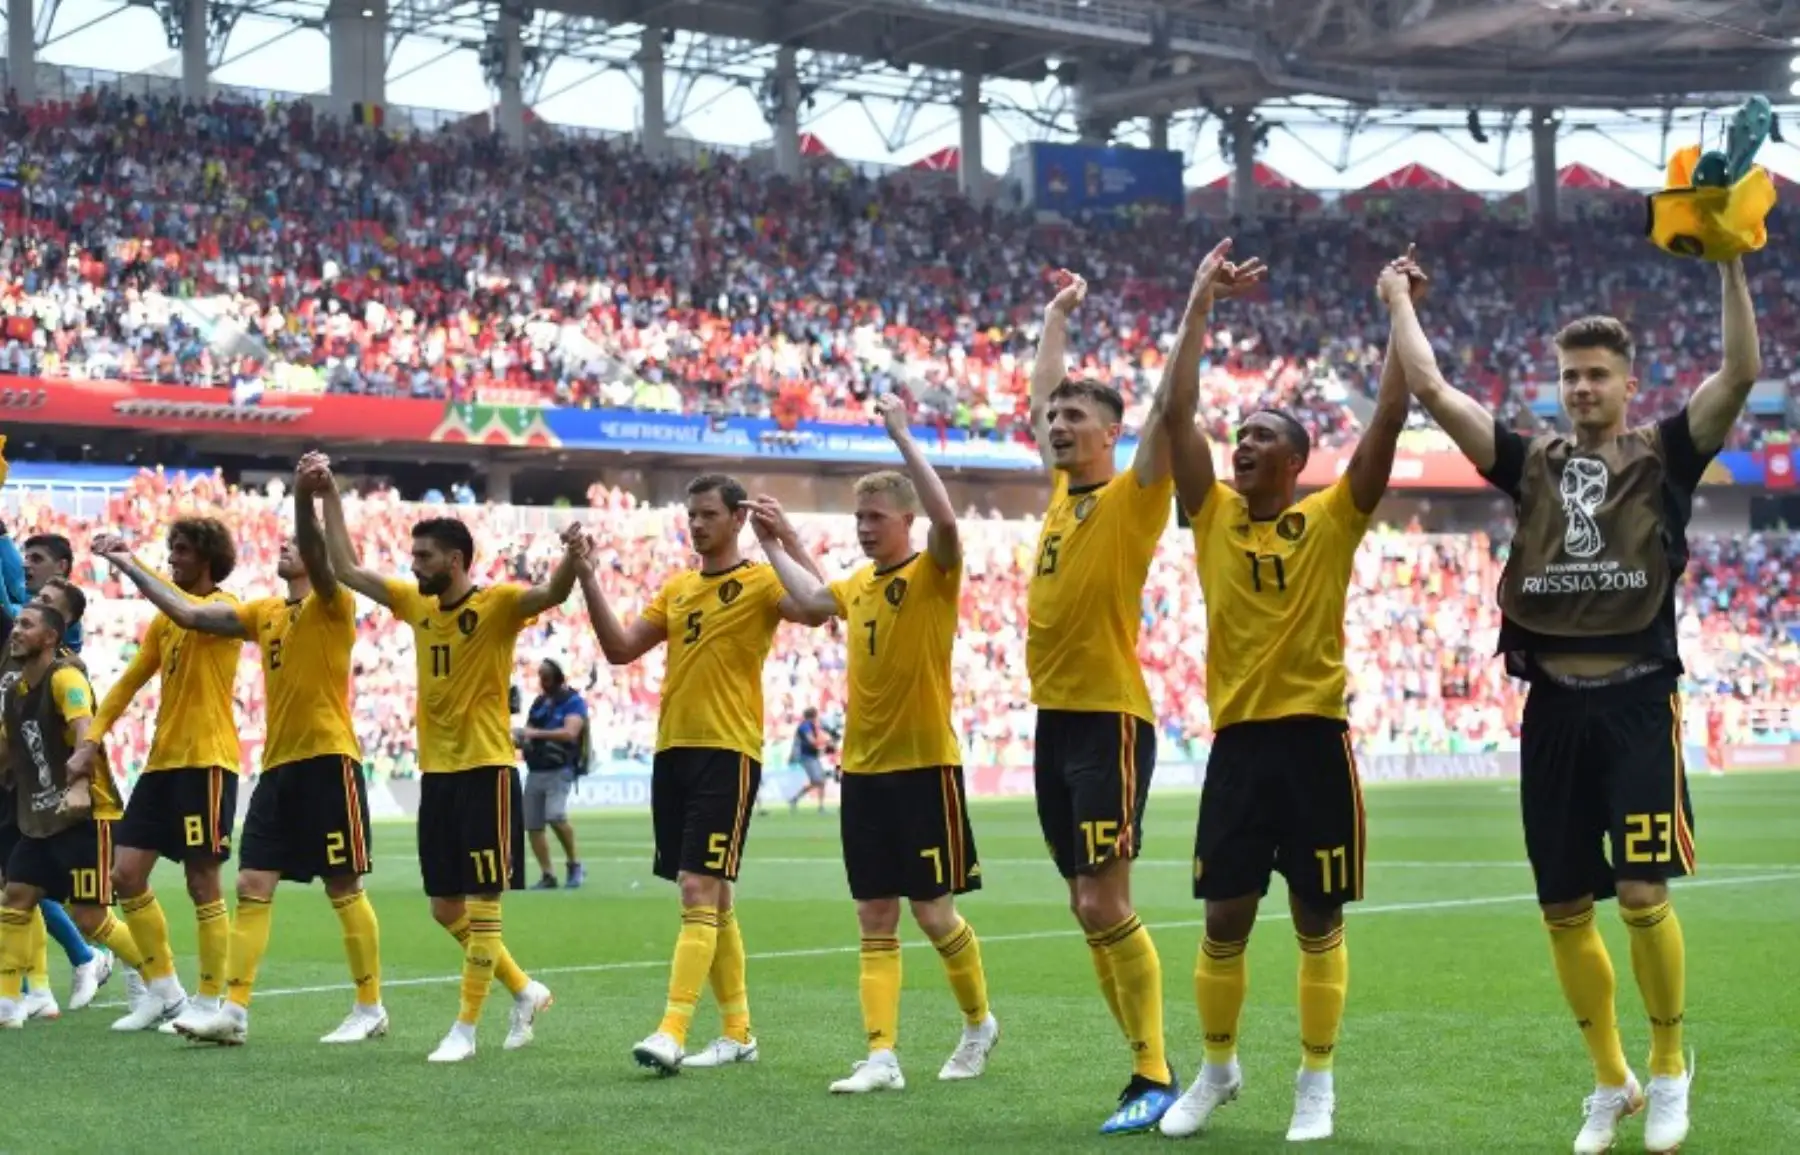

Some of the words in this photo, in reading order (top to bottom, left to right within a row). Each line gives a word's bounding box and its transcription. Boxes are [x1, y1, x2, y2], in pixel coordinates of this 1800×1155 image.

[1522, 574, 1597, 593] RUSSIA
[1600, 570, 1648, 591] 2018
[683, 608, 703, 644] 5
[430, 645, 450, 677] 11
[184, 815, 204, 847] 8
[326, 832, 347, 865] 2
[1080, 821, 1118, 865] 15
[1625, 813, 1672, 862] 23
[470, 849, 497, 884] 11
[704, 833, 727, 869] 5
[920, 847, 943, 884] 7
[70, 868, 97, 898] 10
